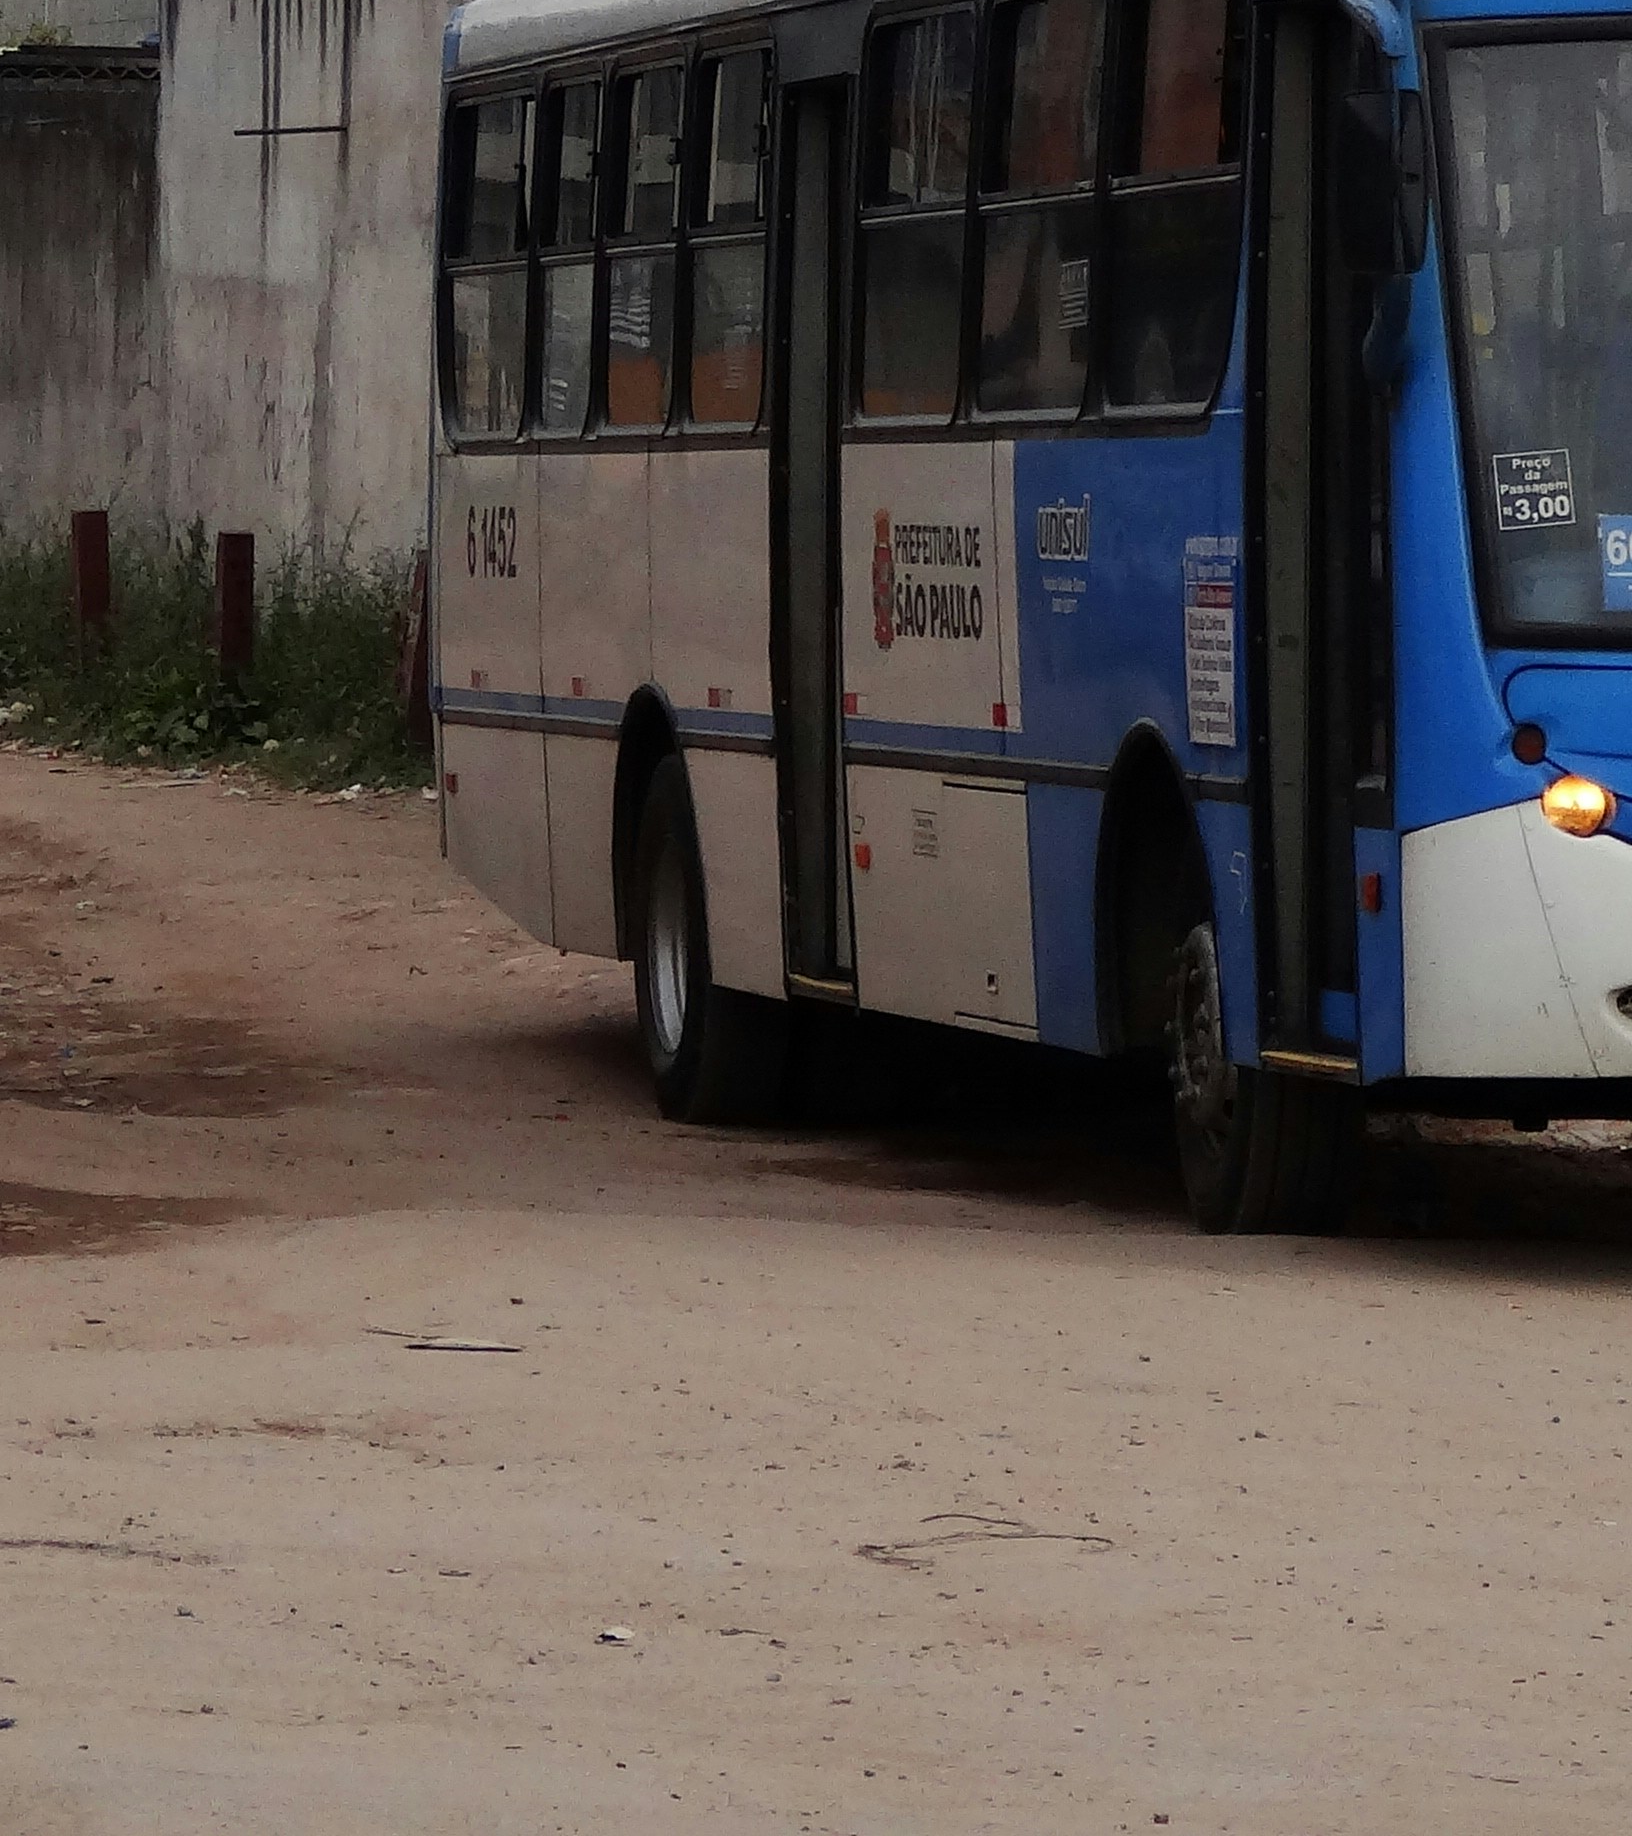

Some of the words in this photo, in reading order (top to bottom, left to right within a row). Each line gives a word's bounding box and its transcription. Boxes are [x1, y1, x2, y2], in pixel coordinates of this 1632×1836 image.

[1512, 457, 1551, 470] Preço
[1524, 470, 1541, 481] da
[1500, 481, 1568, 495] Passagem
[481, 505, 517, 578] 1452
[894, 525, 962, 566] PREFEITURA
[964, 527, 982, 568] DE
[895, 573, 927, 639] SÃO
[929, 584, 984, 640] PAULO
